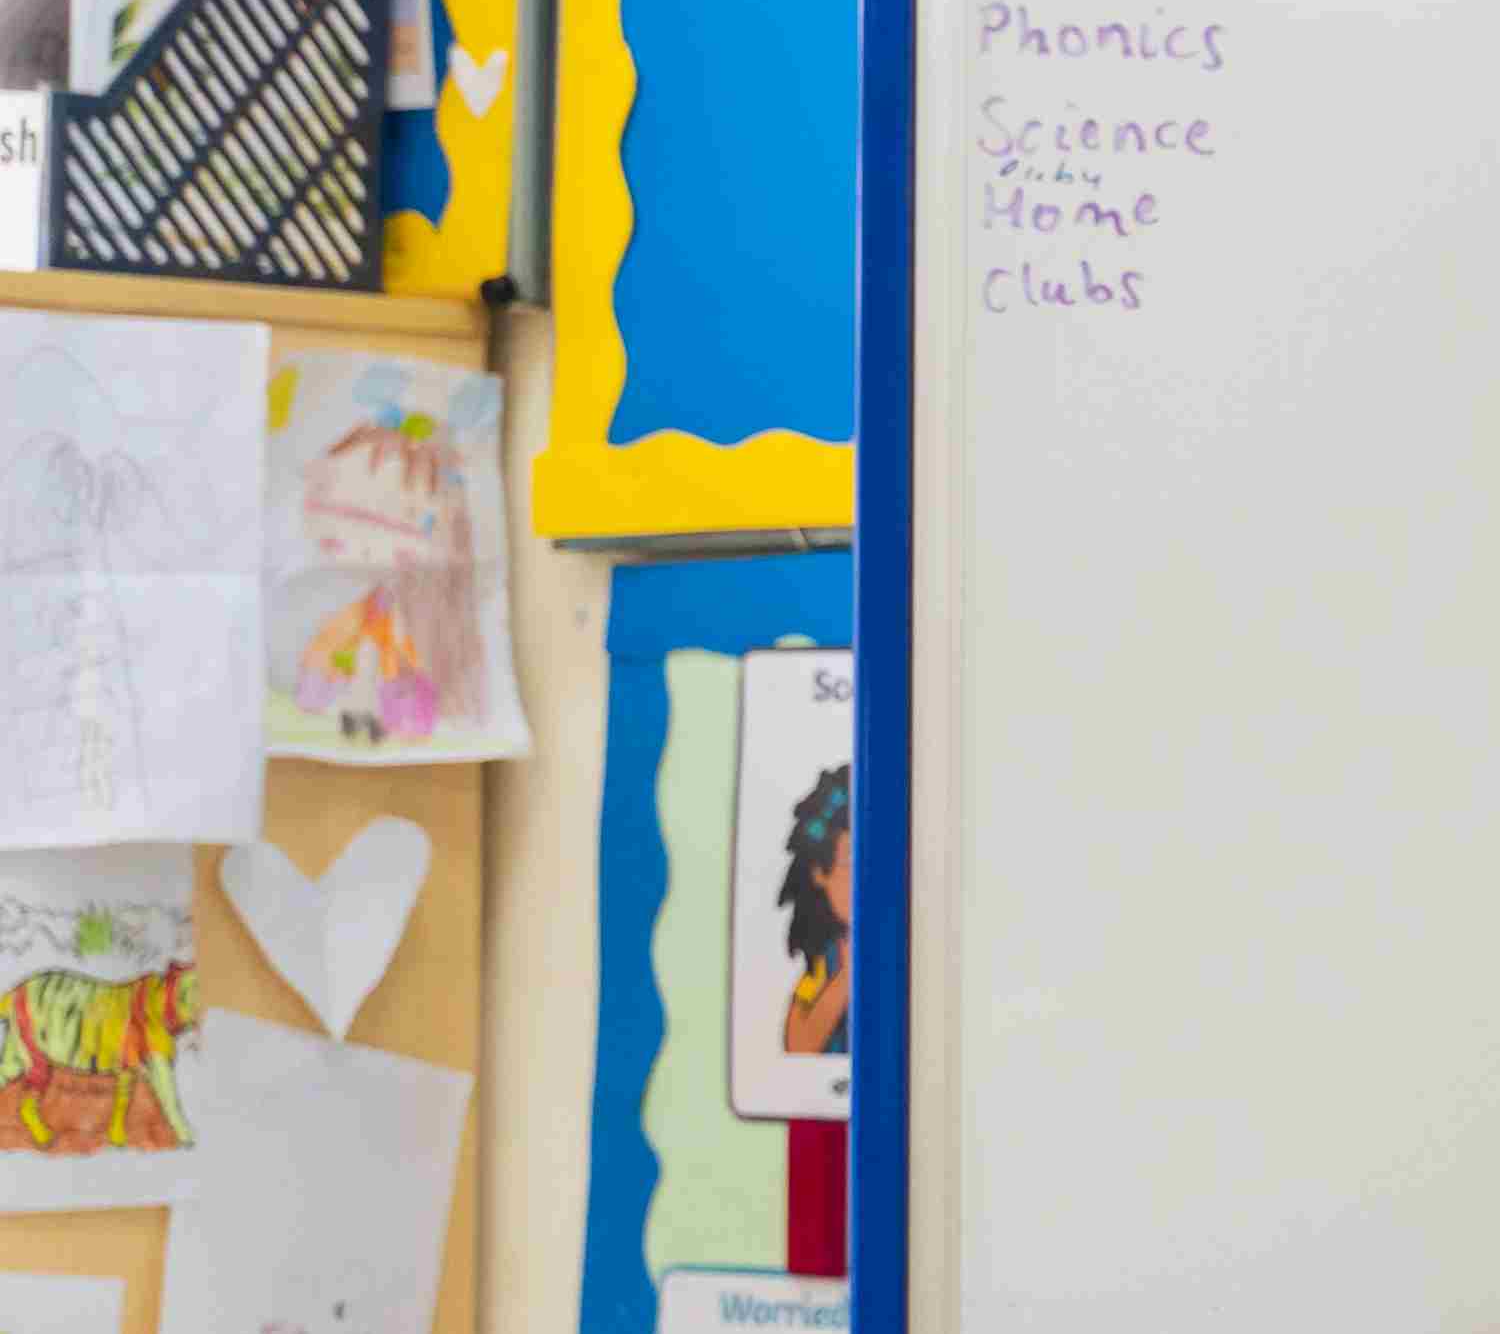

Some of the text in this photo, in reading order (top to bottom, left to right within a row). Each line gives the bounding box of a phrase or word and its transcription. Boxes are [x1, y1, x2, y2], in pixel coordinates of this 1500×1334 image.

[976, 1, 1225, 70] Phonics
[0, 117, 38, 163] sh
[975, 96, 1216, 161] Science
[982, 182, 1160, 237] Home
[982, 261, 1144, 313] Clubs
[719, 1293, 850, 1329] Worried
